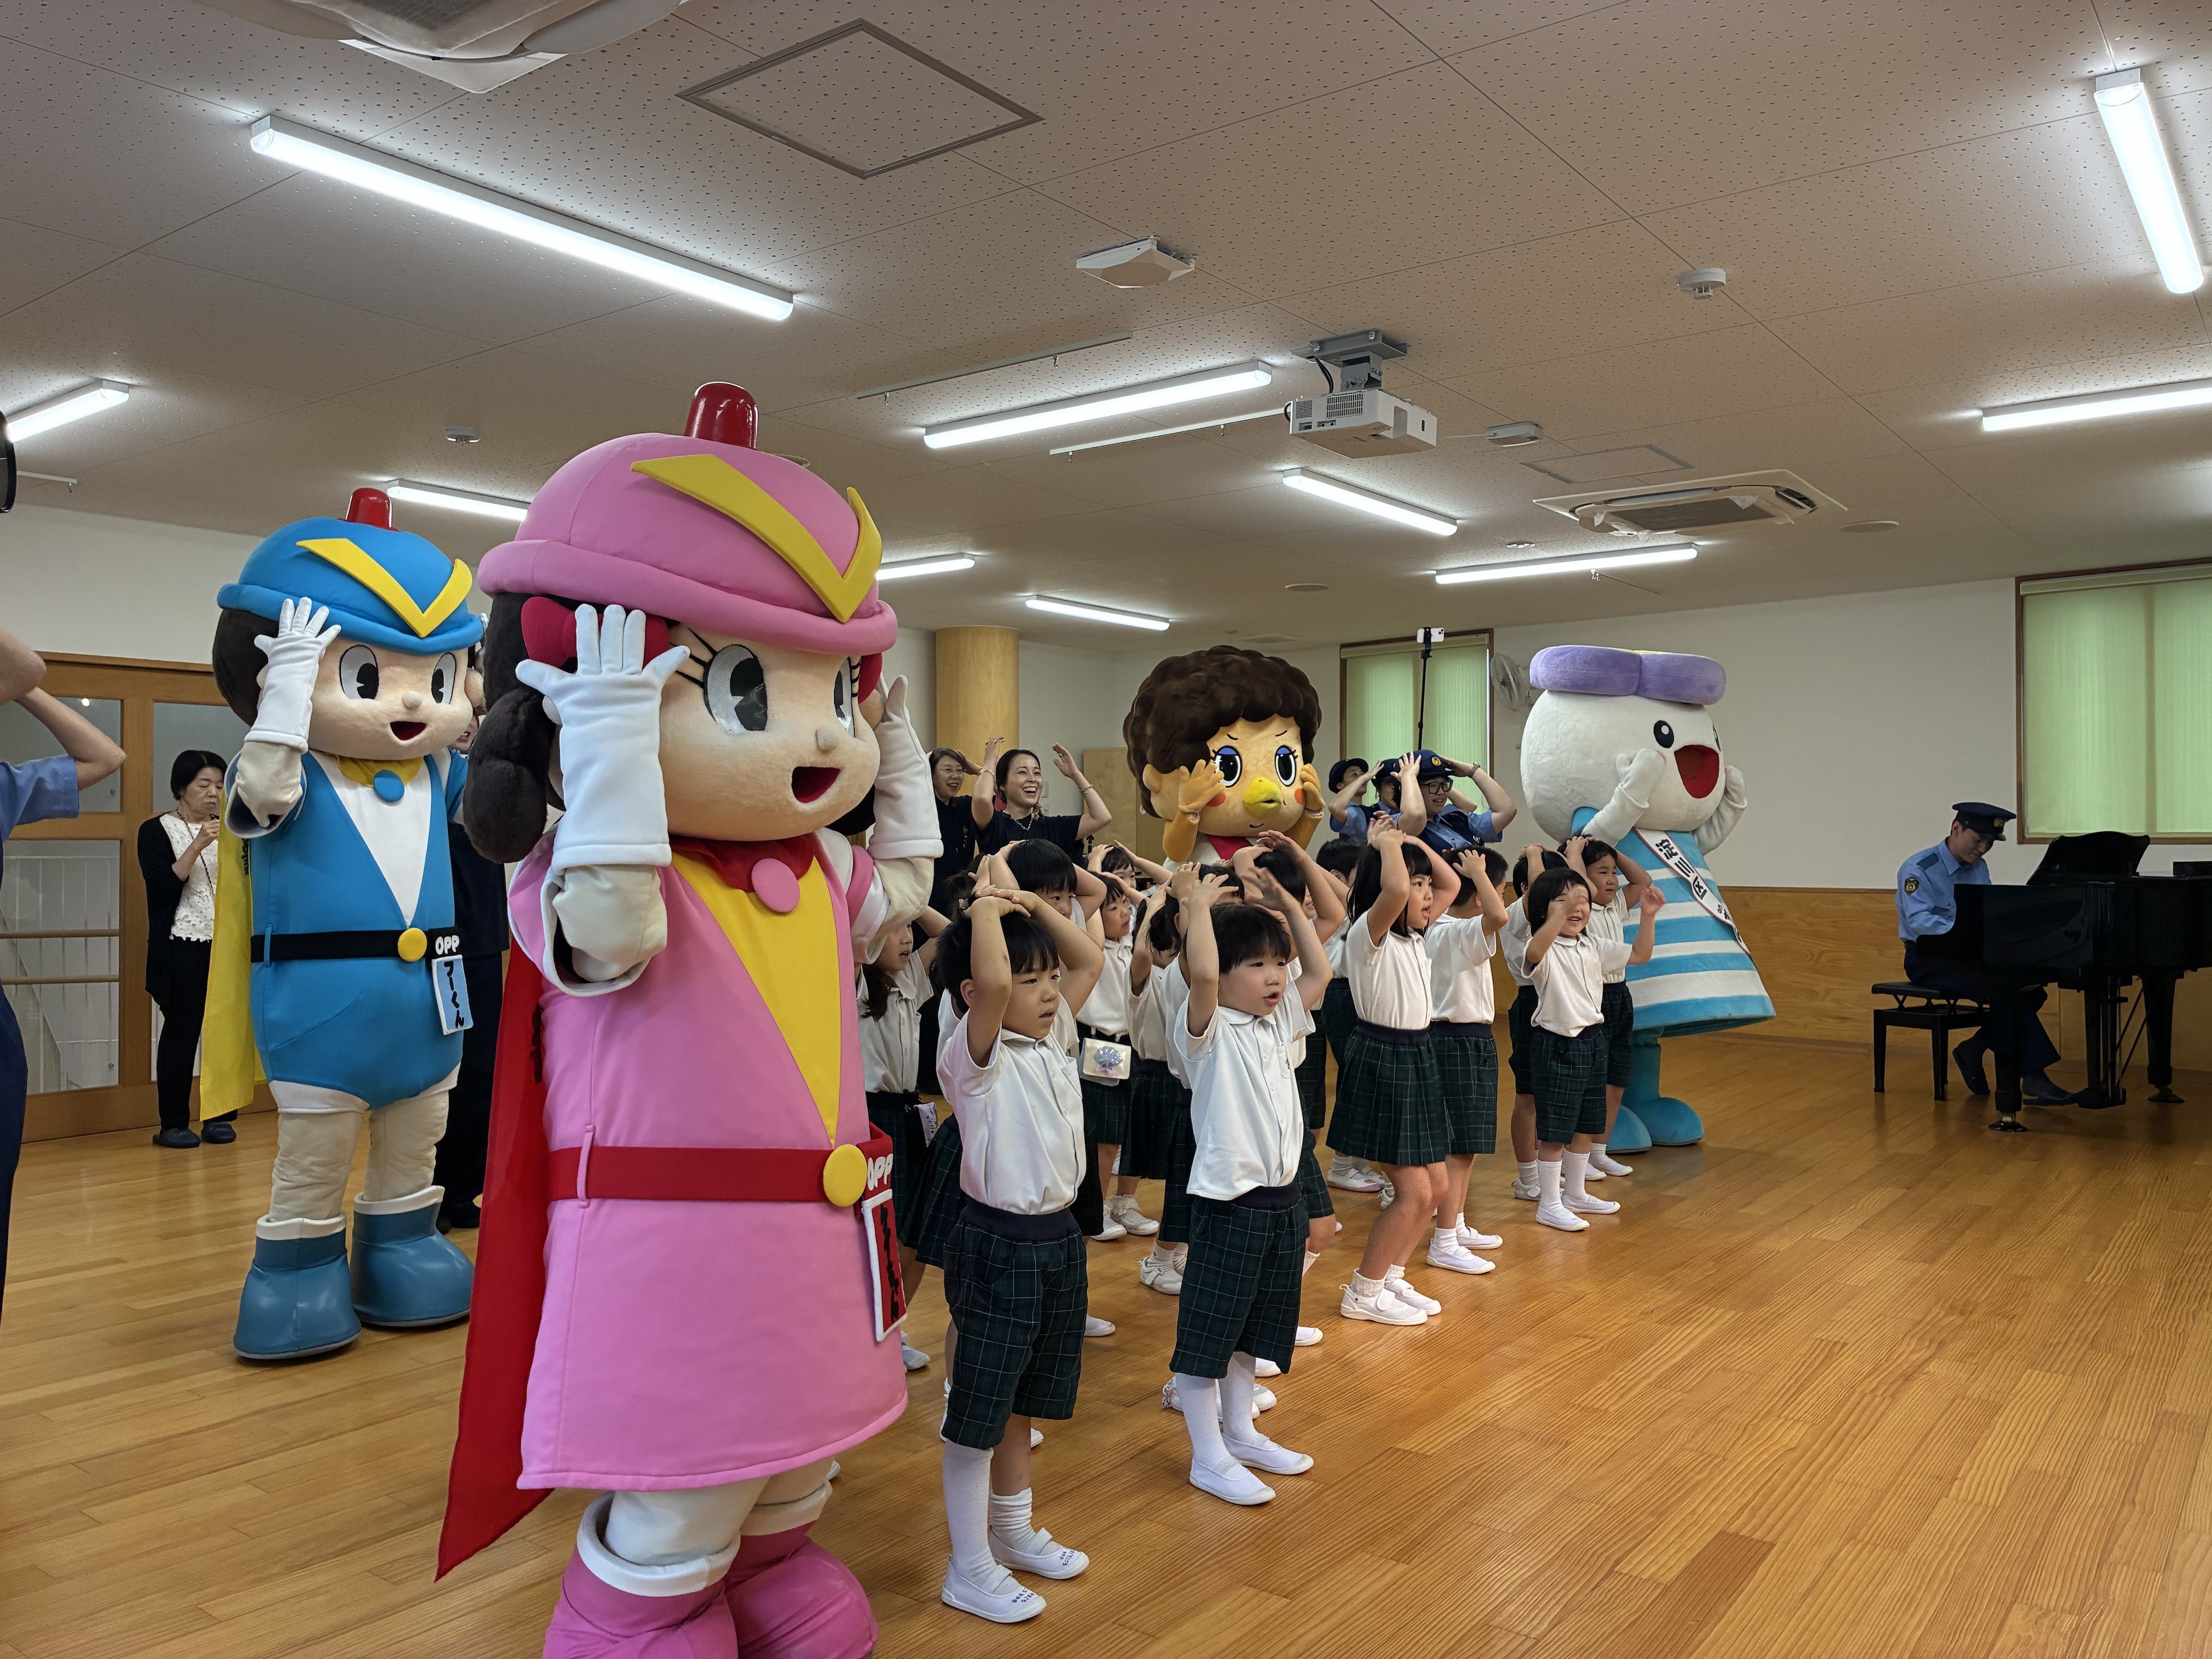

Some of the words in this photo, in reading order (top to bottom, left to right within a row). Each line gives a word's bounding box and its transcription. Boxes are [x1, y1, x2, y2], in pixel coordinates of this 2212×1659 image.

[1655, 839, 1707, 900] 淀川区
[435, 935, 460, 955] OPP
[444, 961, 464, 1028] フーくん
[867, 1153, 893, 1191] OPP
